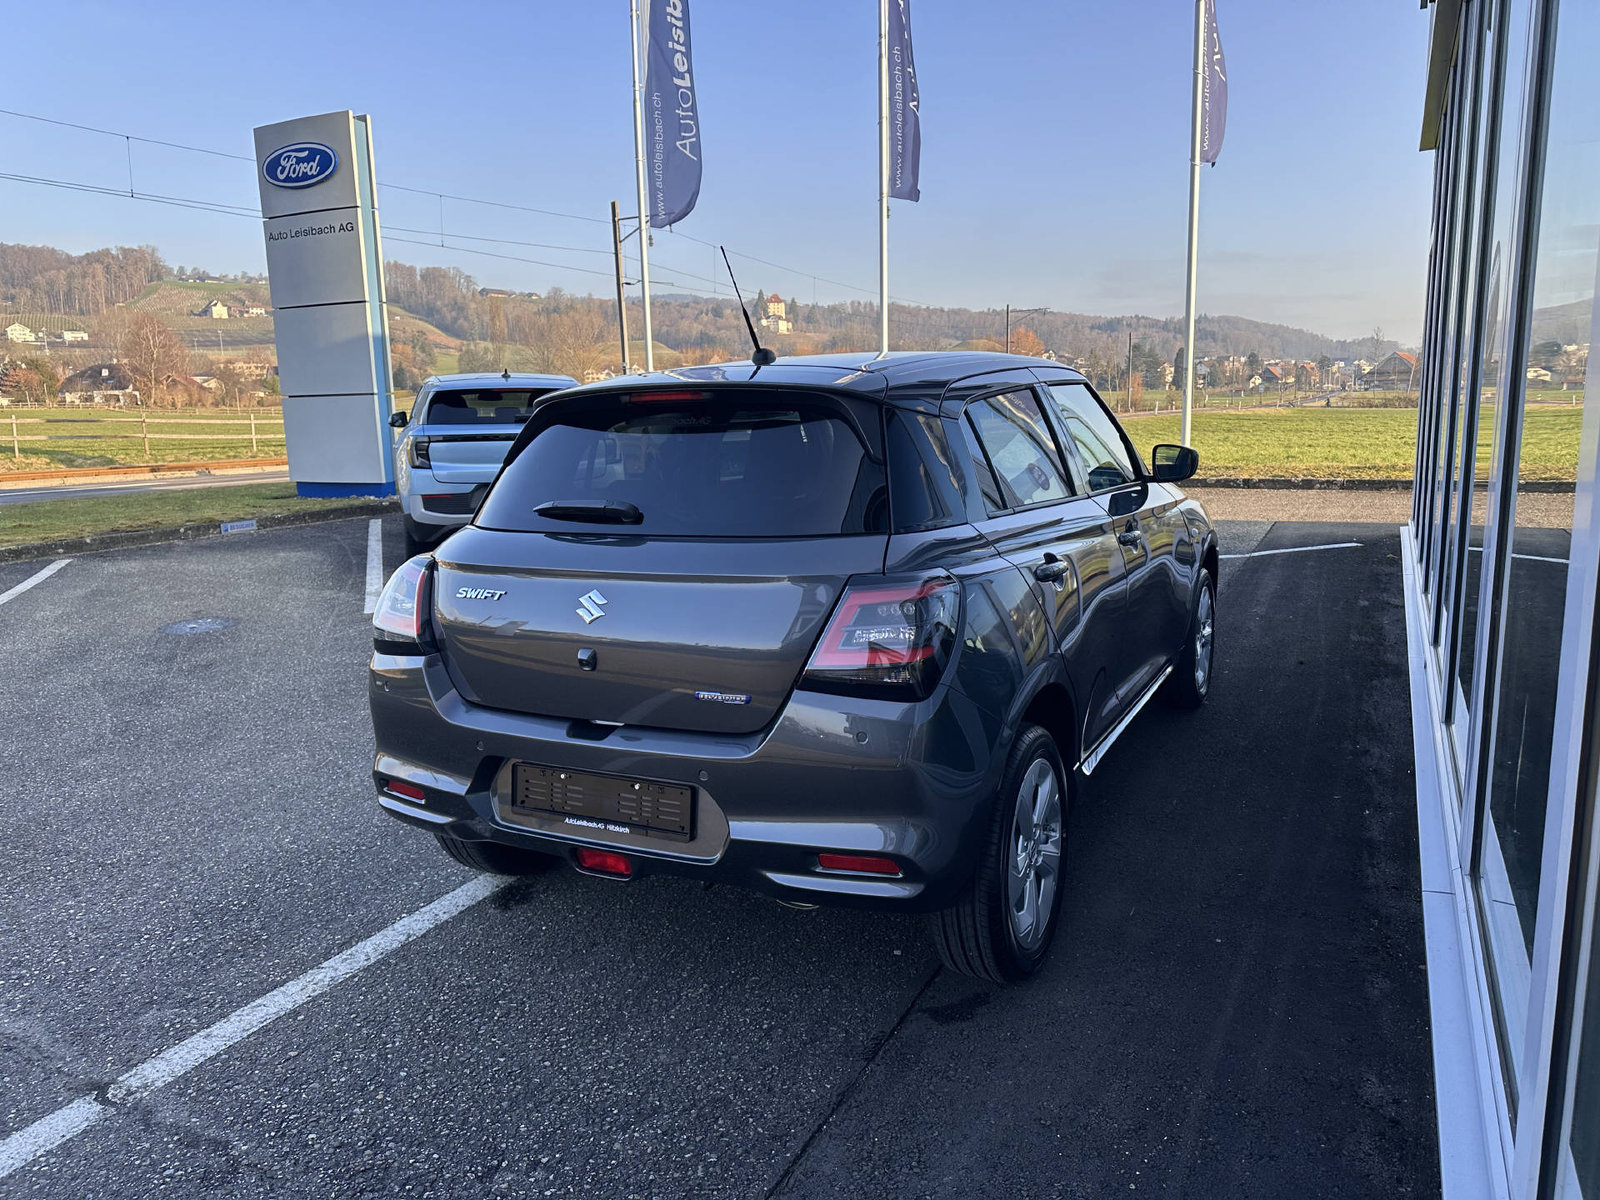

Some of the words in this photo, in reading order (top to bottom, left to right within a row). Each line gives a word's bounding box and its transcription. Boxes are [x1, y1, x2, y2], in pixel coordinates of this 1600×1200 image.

[892, 46, 902, 188] www.autoleisibach.ch
[277, 150, 321, 180] Ford
[652, 92, 666, 220] www.autoleisibach.ch
[268, 231, 288, 242] Auto
[289, 224, 336, 238] Leisibach
[338, 222, 354, 233] AG
[456, 587, 506, 601] SWIFT
